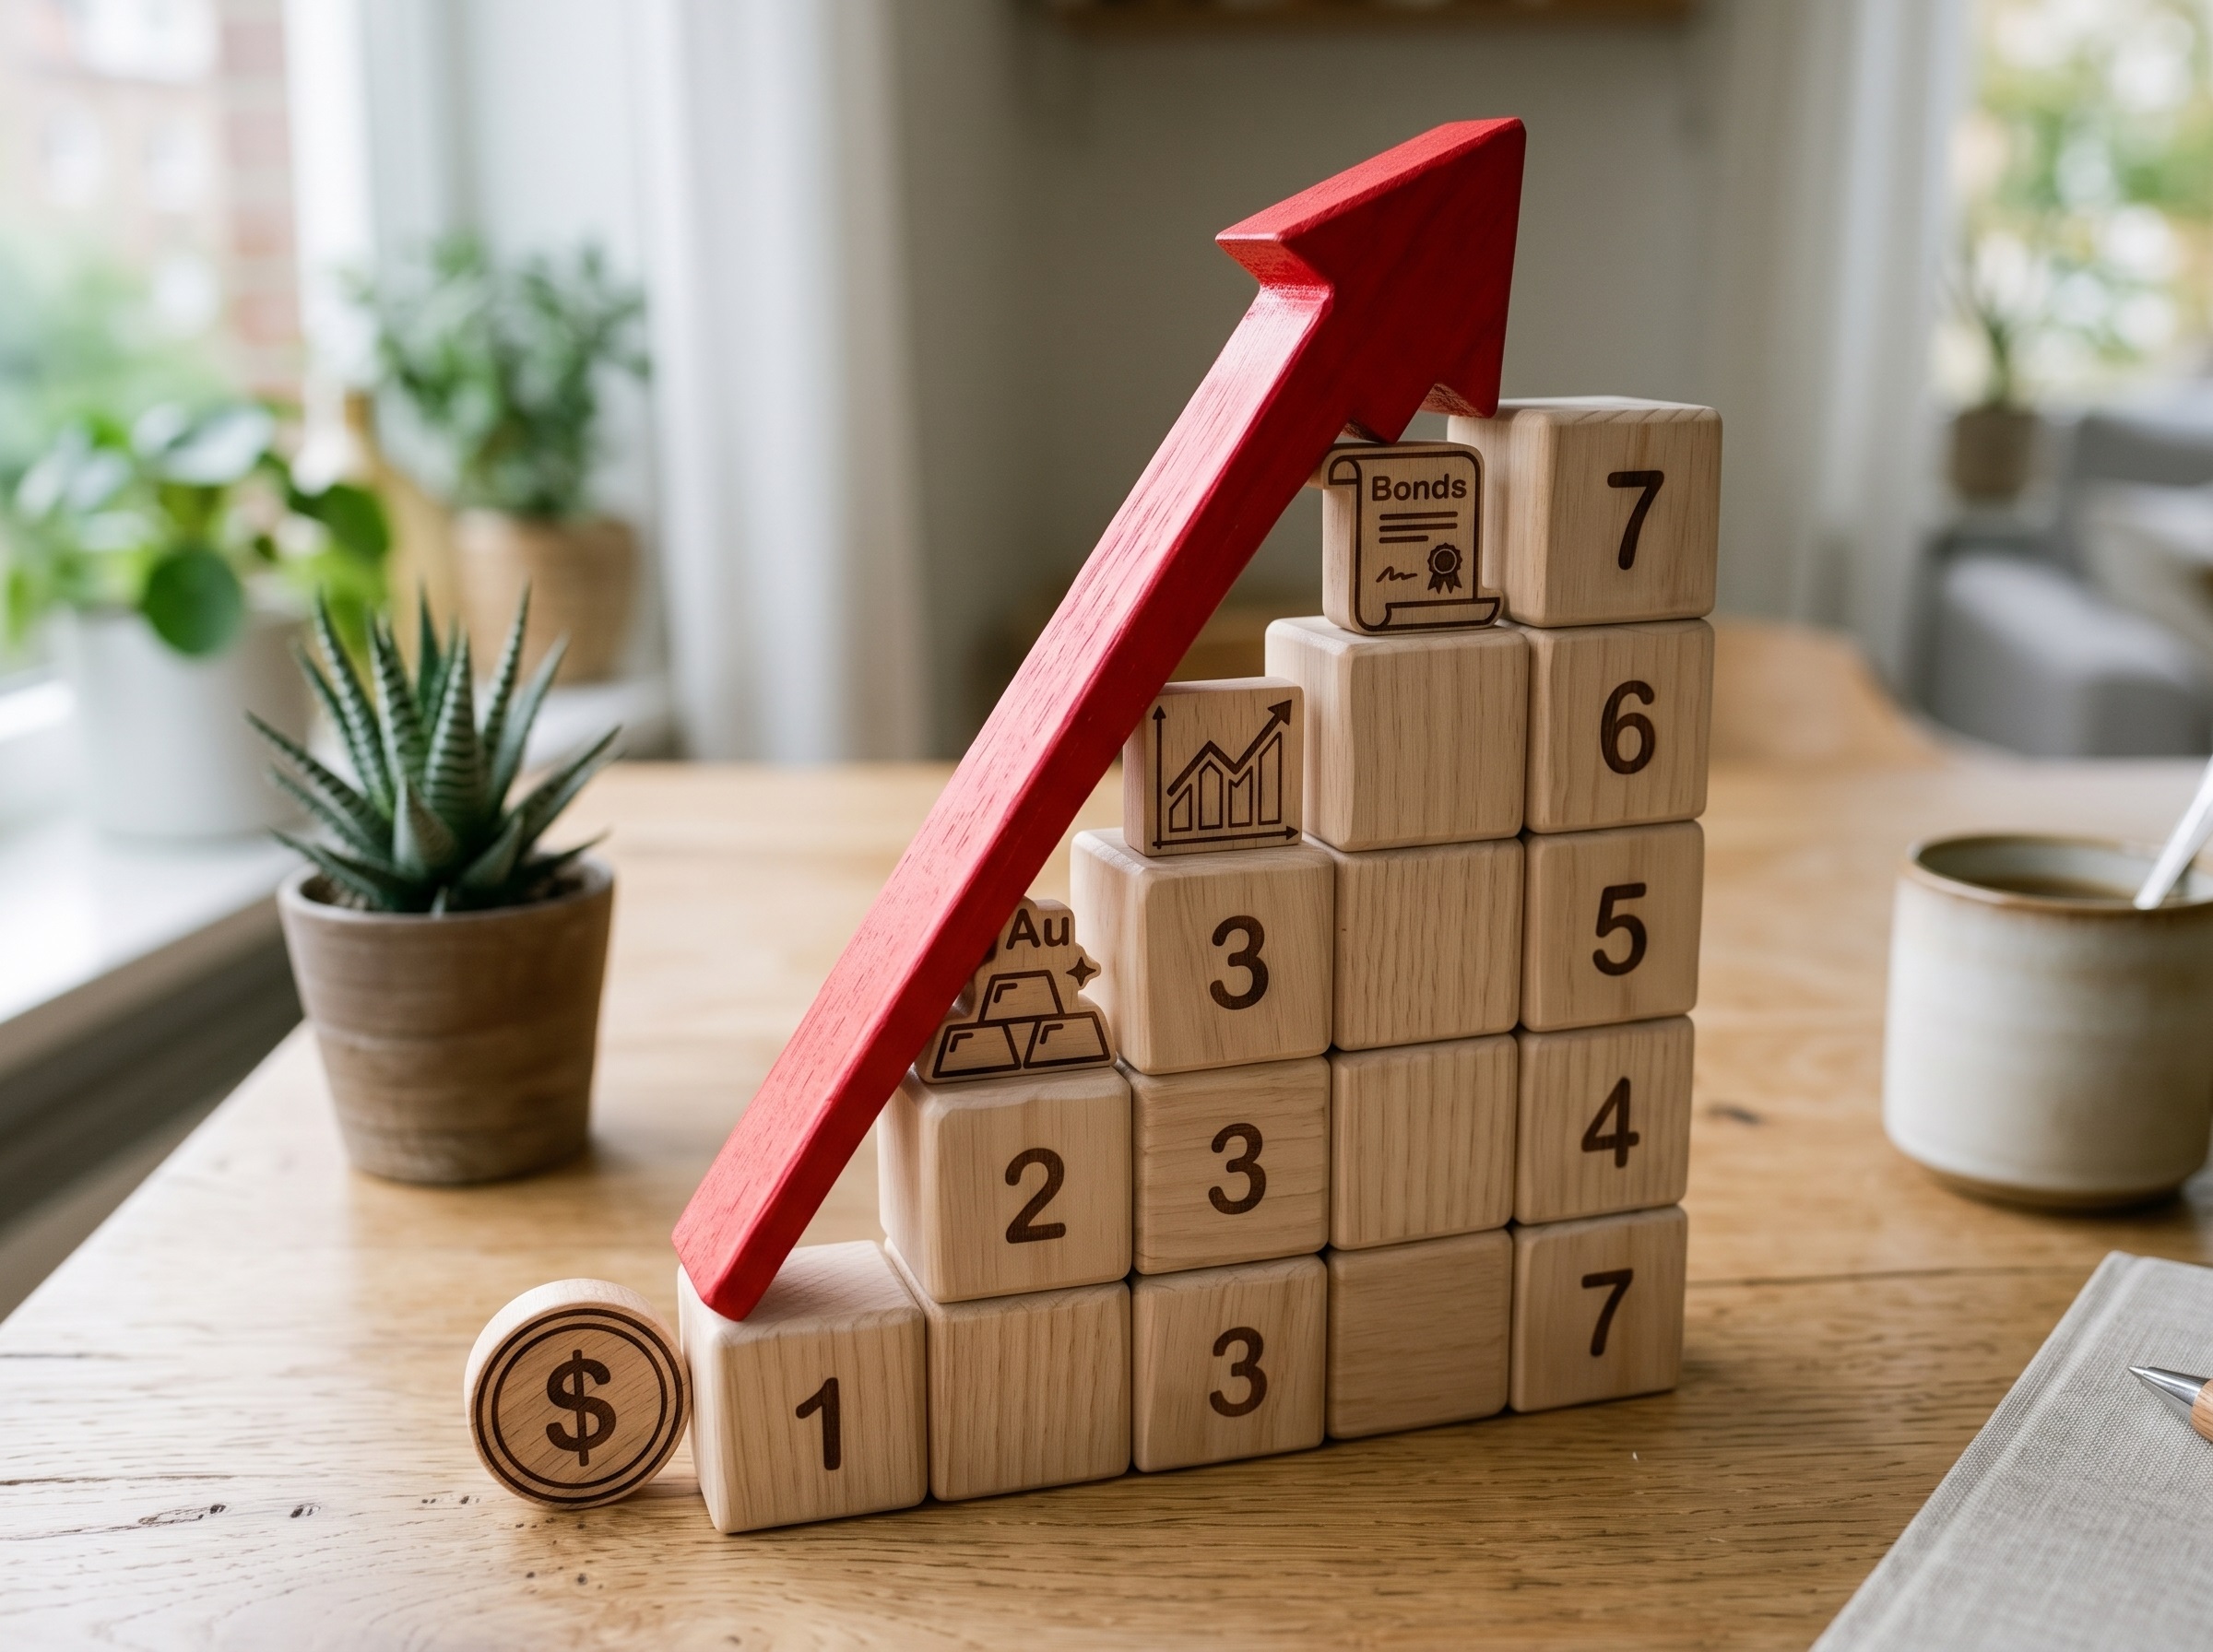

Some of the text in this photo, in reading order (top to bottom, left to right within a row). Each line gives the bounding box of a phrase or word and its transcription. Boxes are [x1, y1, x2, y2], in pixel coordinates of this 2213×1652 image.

[1371, 473, 1467, 502] Bonds
[1606, 469, 1665, 571] 7
[1600, 679, 1656, 775] 6
[1005, 908, 1070, 950] Au
[1209, 914, 1270, 1010] 3
[1592, 881, 1648, 977] 5
[1208, 1122, 1267, 1215] 3
[1580, 1077, 1640, 1169] 4
[1004, 1147, 1067, 1245] 2
[1581, 1268, 1634, 1358] 7
[545, 1349, 617, 1468] $
[1209, 1327, 1268, 1418] 3
[795, 1376, 842, 1471] 1
